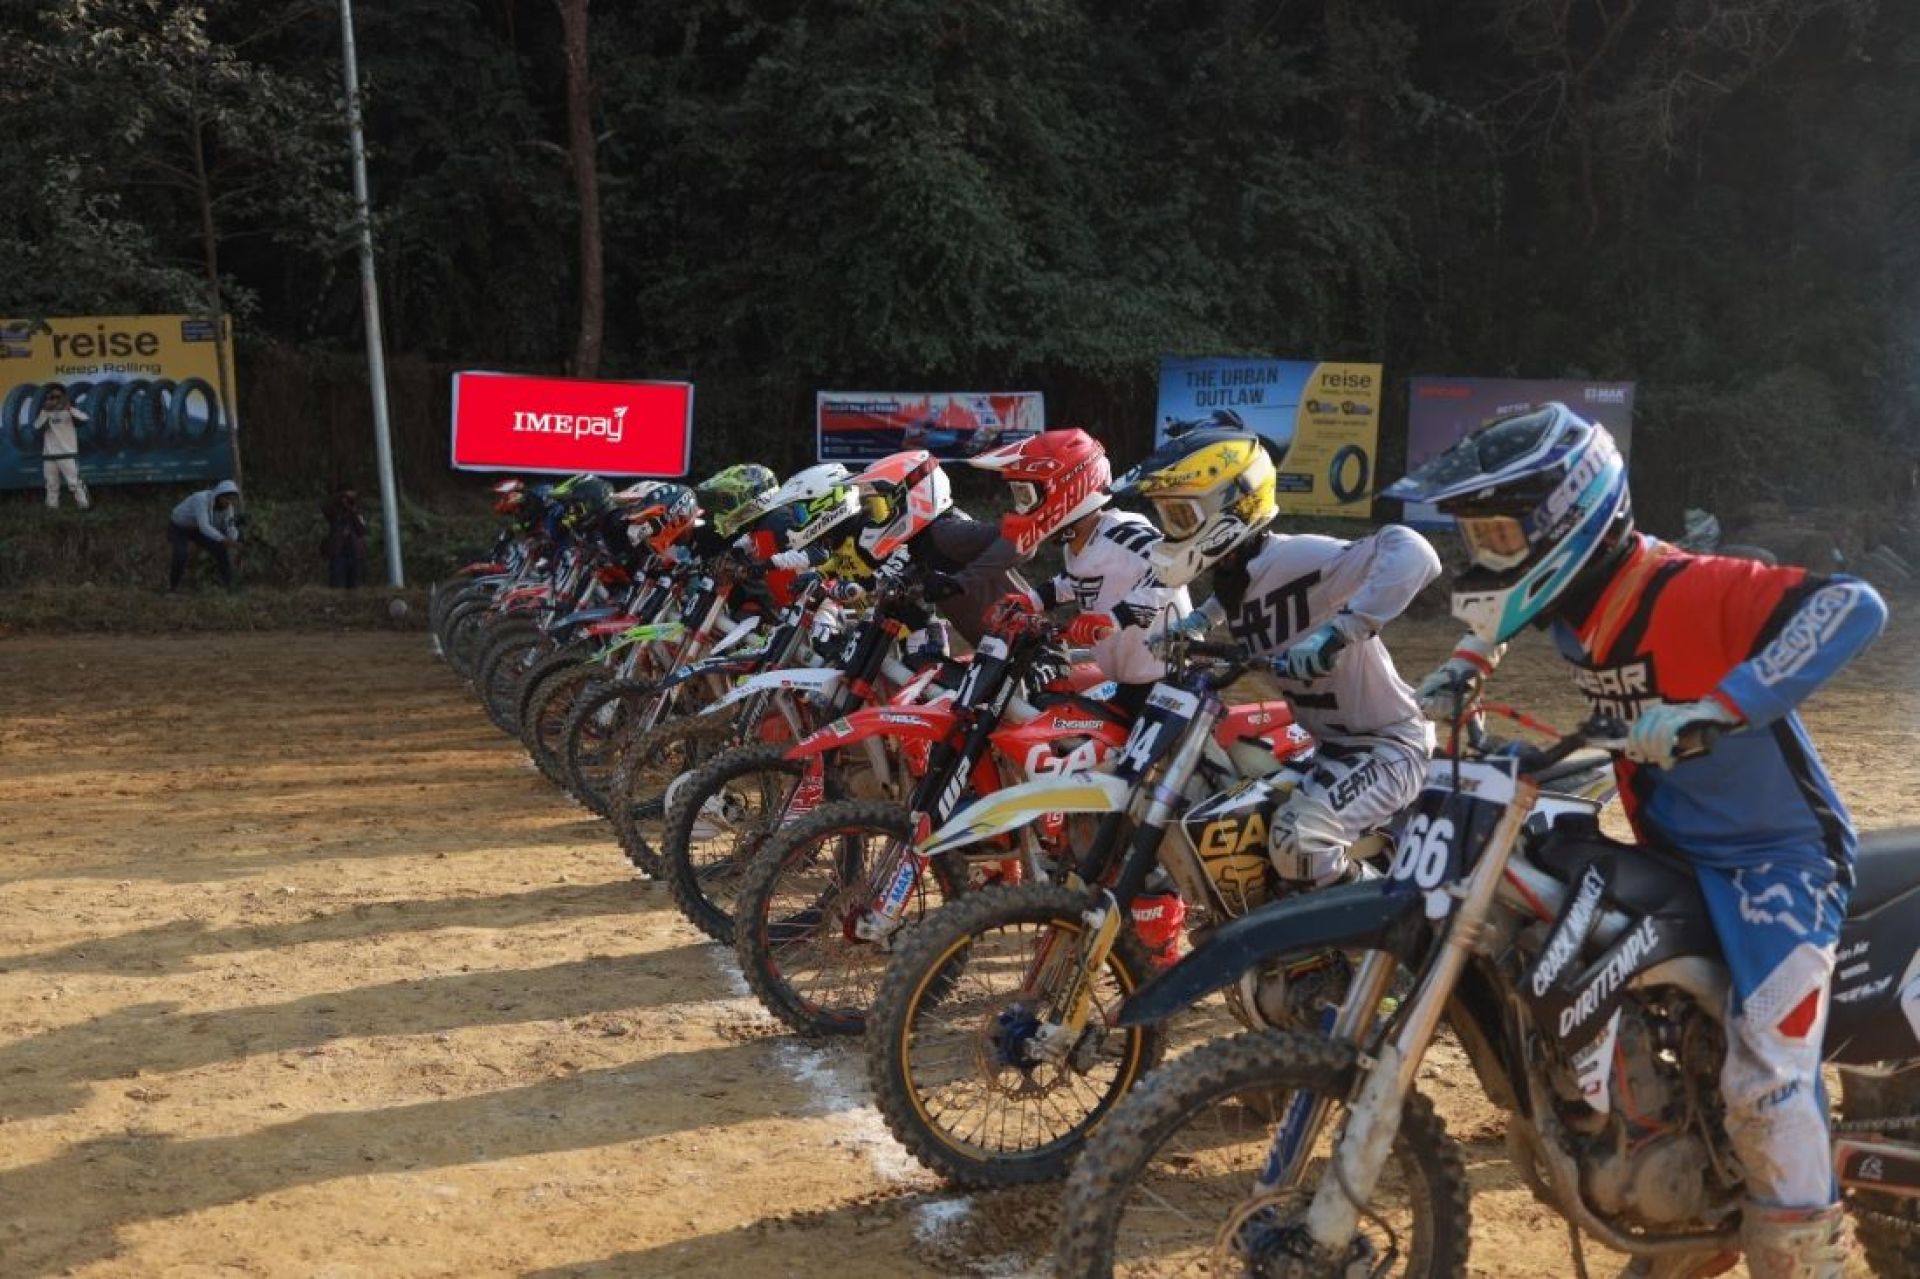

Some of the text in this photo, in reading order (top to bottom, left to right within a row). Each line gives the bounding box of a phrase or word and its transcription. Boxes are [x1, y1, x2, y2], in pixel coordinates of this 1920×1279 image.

[53, 324, 160, 358] reise
[103, 363, 161, 374] Rolling
[1186, 368, 1278, 387] THE URBAN
[1321, 370, 1372, 388] reise
[1196, 389, 1265, 407] OUTLAW
[1392, 814, 1456, 889] 66
[1531, 928, 1577, 997] CRACK
